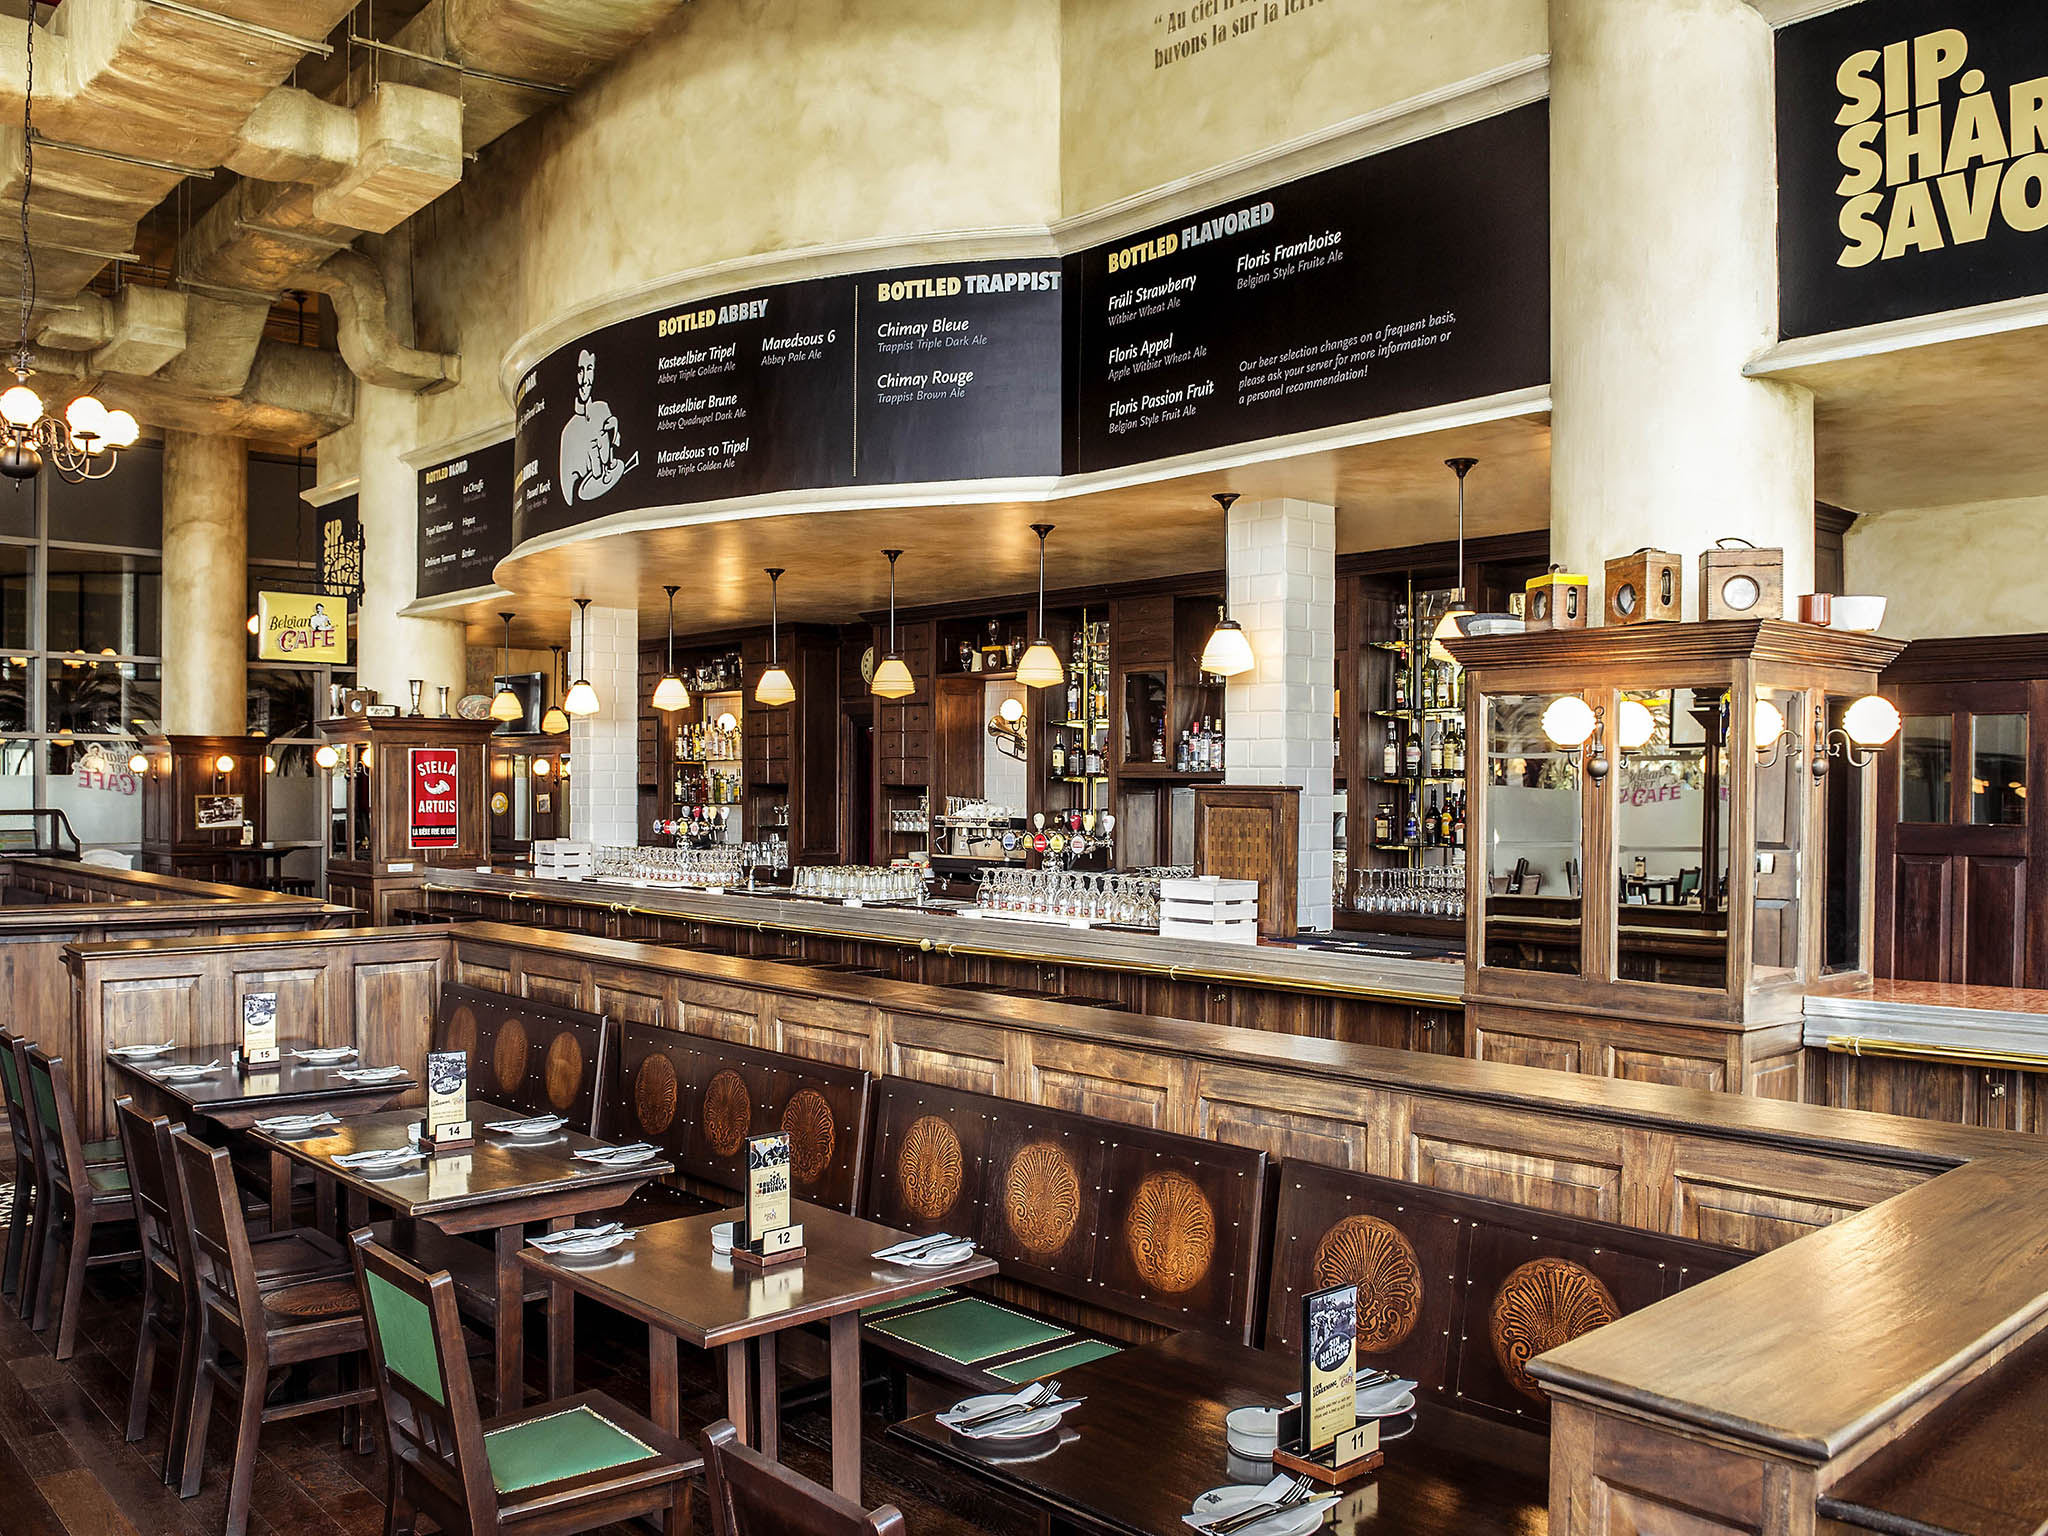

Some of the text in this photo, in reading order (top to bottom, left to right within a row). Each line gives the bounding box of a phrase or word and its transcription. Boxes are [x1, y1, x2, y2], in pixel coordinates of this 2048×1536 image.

[1168, 12, 1186, 34] Au
[1154, 32, 1207, 69] buvons
[1212, 24, 1227, 46] la
[1232, 11, 1258, 38] sur
[1264, 2, 1279, 25] la
[1834, 28, 1985, 126] SIP.
[1108, 202, 1275, 273] BOTTLED FLAVORED
[1237, 230, 1342, 273] Floris Framboise
[1236, 274, 1270, 290] Belgian
[1272, 263, 1295, 280] Style
[1327, 250, 1343, 263] Ale
[878, 271, 1061, 302] BOTTLED TRAPPIST
[1108, 275, 1197, 311] Früli Strawberry
[658, 299, 768, 337] BOTTLED ABBEY
[1108, 296, 1181, 327] Witbier Wheat Ale
[877, 318, 969, 338] Chimay Bleue
[762, 329, 836, 351] Maredsous 6
[877, 334, 988, 354] Trappist Triple Dark Ale
[1108, 332, 1174, 364] Floris Appel
[1239, 310, 1456, 372] Our beer selection changes on a frequent basis,
[658, 343, 736, 370] Kasteelbier Tripel
[761, 350, 822, 366] Abbey Pale Ale
[1108, 345, 1207, 382] Apple Witbier Wheat Ale
[1238, 331, 1452, 391] please ask your server for more information or
[657, 371, 677, 384] Abbey
[697, 365, 721, 377] Golden
[723, 362, 735, 372] Ale
[877, 370, 974, 389] Chimay Rouge
[877, 388, 965, 405] Trappist Brown Ale
[1238, 365, 1368, 406] a personal recommendation!
[657, 393, 737, 417] Kasteelbier Brune
[1109, 379, 1214, 418] Floris Passion Fruit
[657, 418, 676, 431] Abbey
[715, 410, 733, 421] Dark
[735, 408, 746, 418] Ale
[1109, 404, 1197, 432] Belgian Style Fruit Ale
[657, 438, 749, 464] Maredsous 10 Tripel
[425, 467, 448, 485] BOTTLED
[657, 465, 677, 478] Abbey
[697, 460, 721, 472] Golden
[723, 459, 735, 468] Ale
[270, 615, 311, 630] Belgian
[417, 761, 456, 776] STELLA
[418, 800, 456, 813] ARTOIS
[260, 1050, 270, 1058] 15
[449, 1127, 460, 1136] 14
[777, 1232, 790, 1245] 12
[1320, 1340, 1350, 1362] NATIONS
[1329, 1336, 1340, 1349] SIX
[1352, 1431, 1364, 1450] 11
